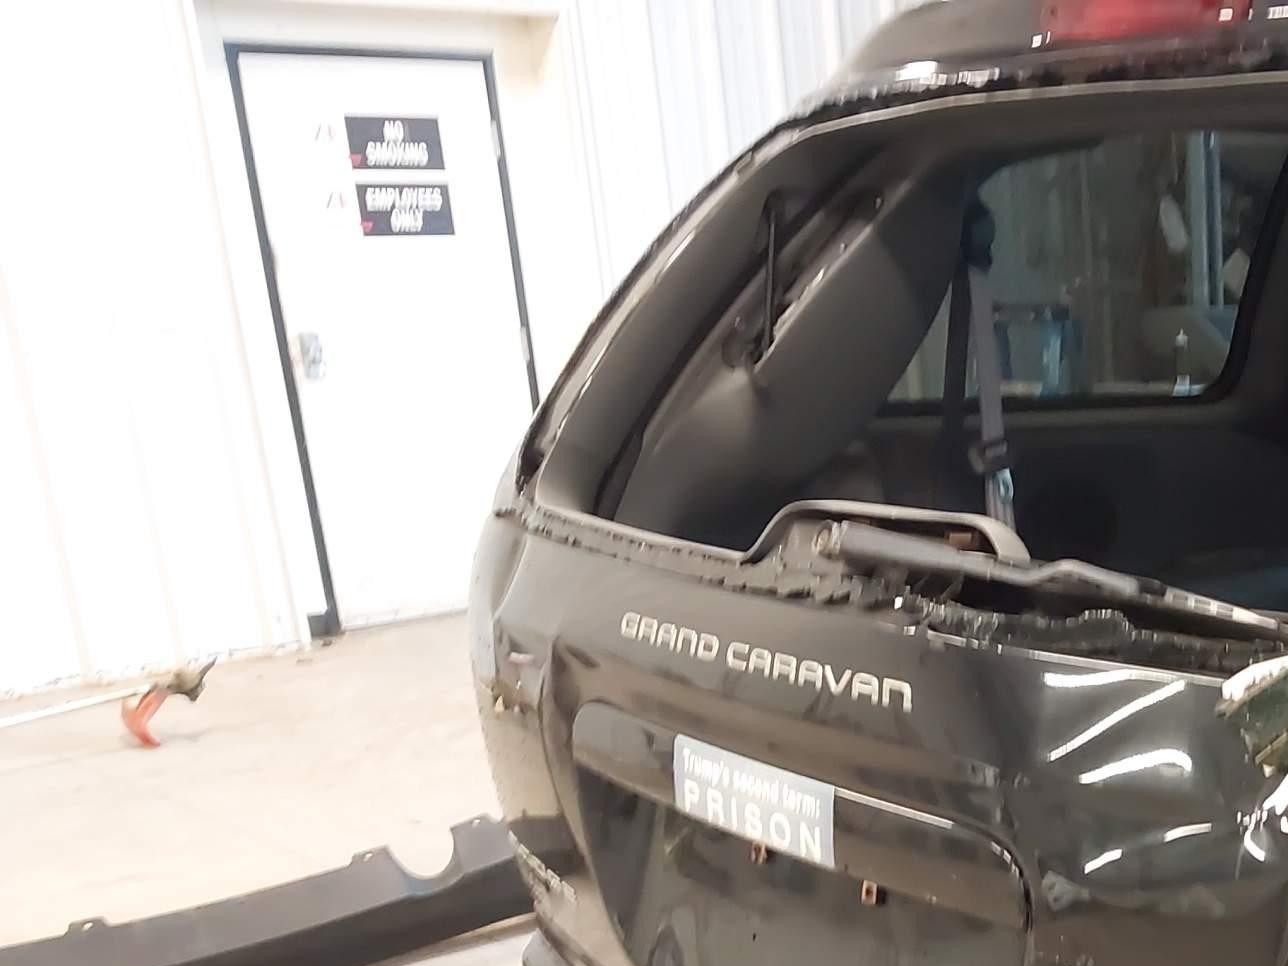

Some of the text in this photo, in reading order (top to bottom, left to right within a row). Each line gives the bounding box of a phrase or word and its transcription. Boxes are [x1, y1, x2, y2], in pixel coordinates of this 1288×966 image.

[383, 119, 404, 142] NO
[365, 141, 429, 167] SMOKING
[365, 186, 443, 212] EMPLOYEES
[390, 208, 424, 233] ONLY
[620, 611, 912, 713] GRAND CARAVAN
[683, 746, 731, 788] Trump's
[733, 769, 780, 804] second
[683, 778, 822, 864] PRISON
